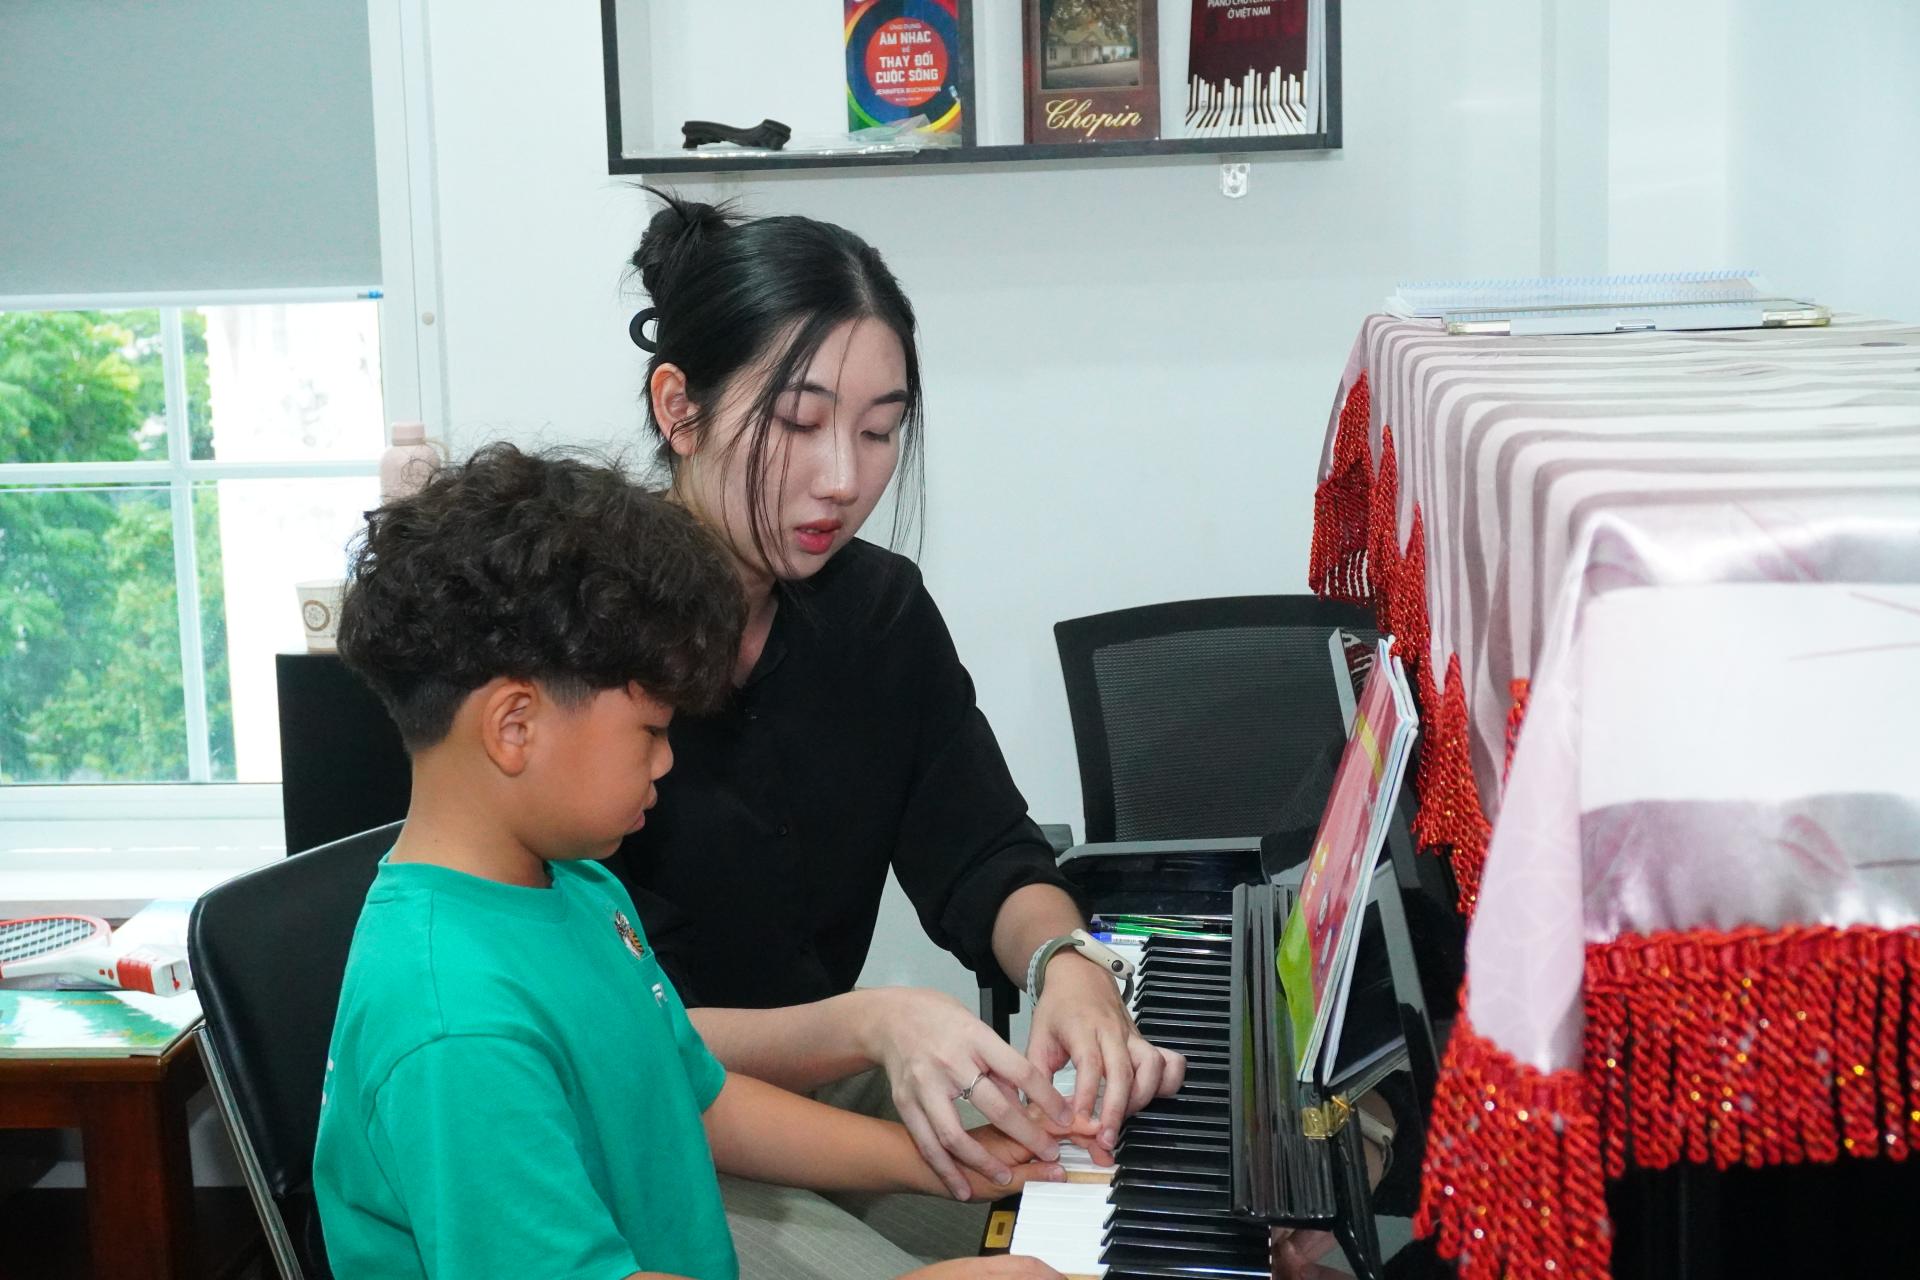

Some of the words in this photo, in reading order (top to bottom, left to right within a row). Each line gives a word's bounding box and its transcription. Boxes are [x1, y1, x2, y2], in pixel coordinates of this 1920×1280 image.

[1235, 7, 1251, 18] VIỆT
[1252, 7, 1270, 16] NAM
[880, 56, 909, 68] THAY
[876, 69, 905, 83] CUỘC
[1046, 98, 1141, 137] Chopin
